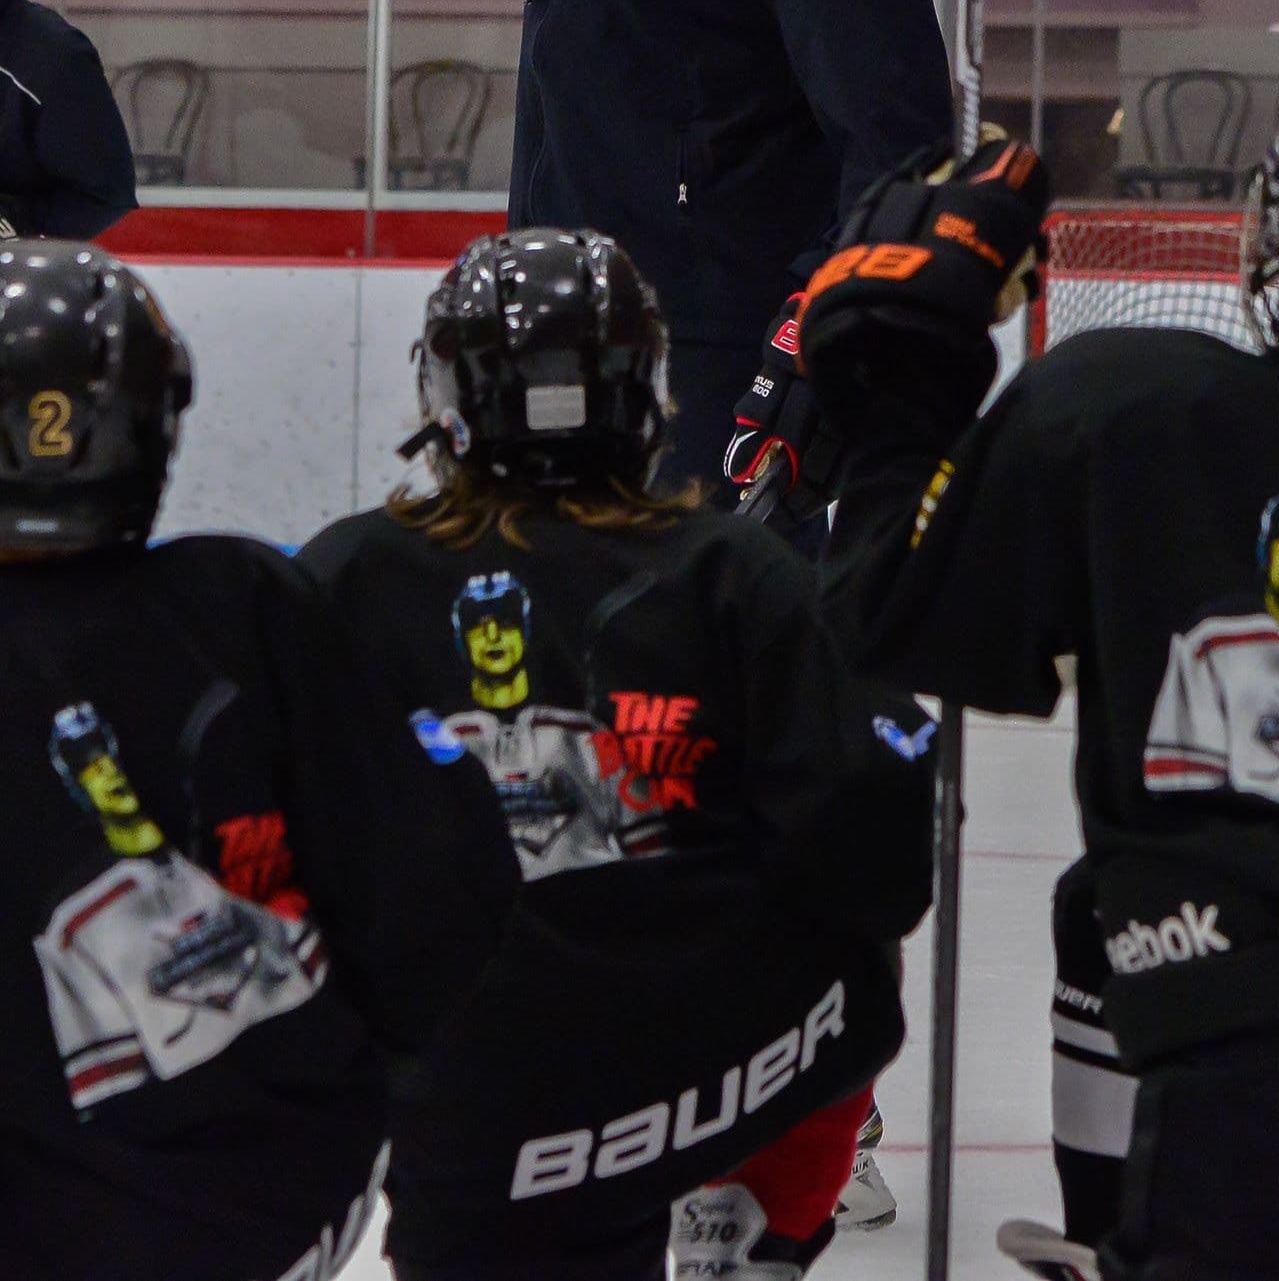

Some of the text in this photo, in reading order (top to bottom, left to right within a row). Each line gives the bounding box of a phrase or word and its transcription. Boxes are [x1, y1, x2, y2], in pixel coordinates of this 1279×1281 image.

[28, 389, 72, 456] 2
[608, 690, 700, 734] THE
[509, 978, 846, 1201] BAUER
